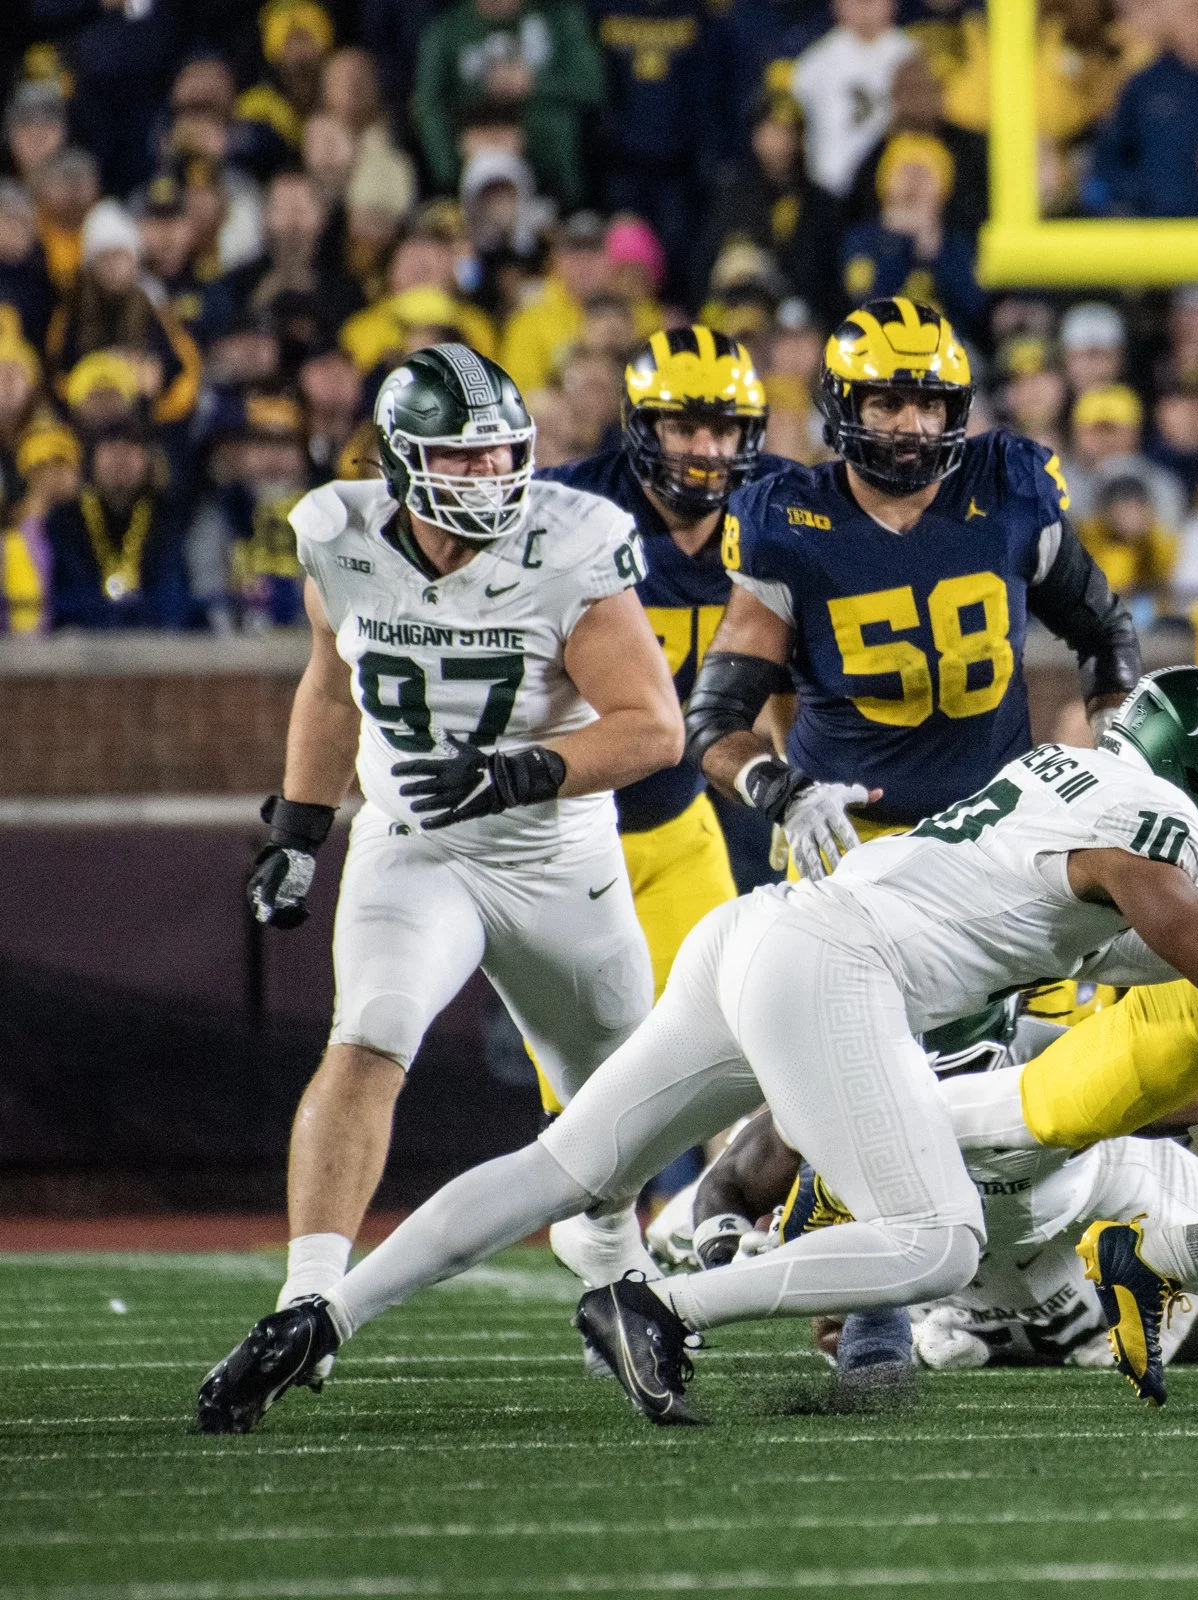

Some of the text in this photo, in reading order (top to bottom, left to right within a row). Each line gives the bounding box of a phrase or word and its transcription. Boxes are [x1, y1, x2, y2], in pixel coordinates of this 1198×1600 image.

[522, 528, 548, 569] C
[613, 528, 644, 584] 9
[357, 616, 525, 650] MICHIGAN STATE
[828, 571, 1014, 727] 58
[357, 651, 525, 753] 97
[1055, 770, 1100, 805] III
[1129, 810, 1190, 865] 10
